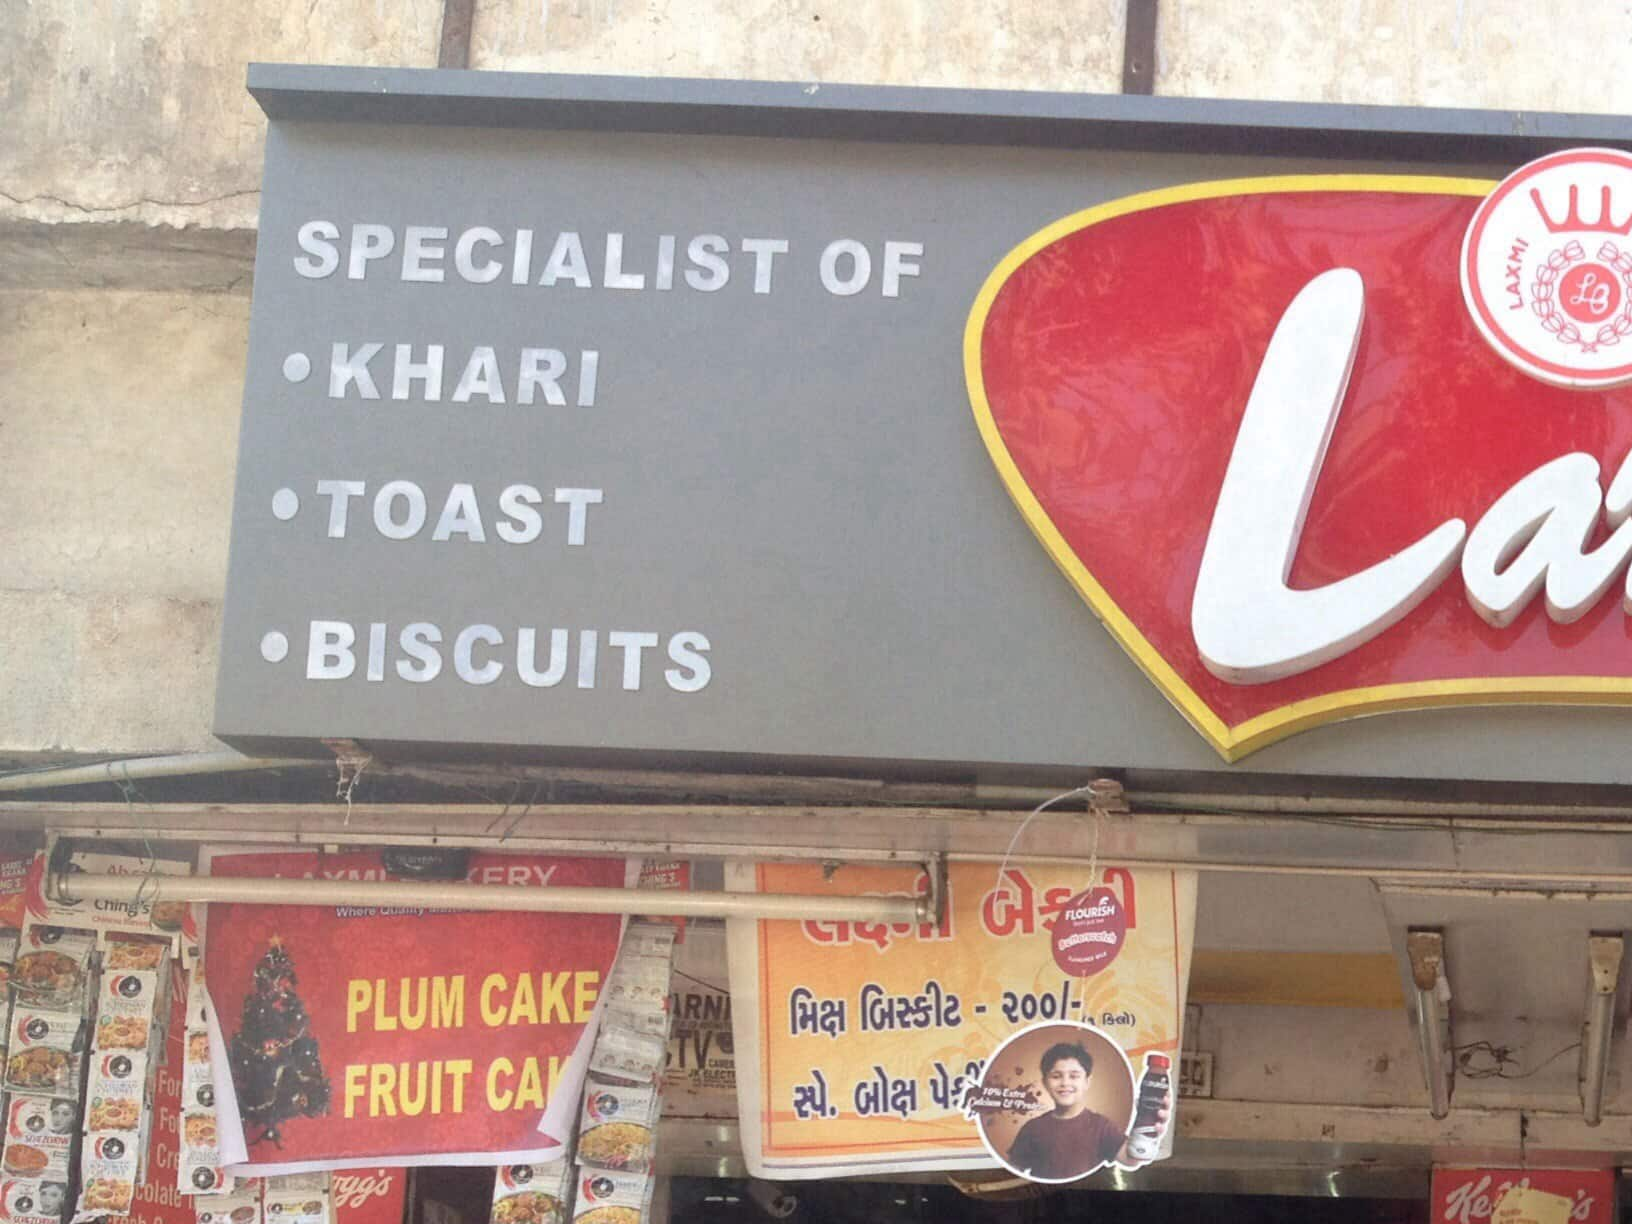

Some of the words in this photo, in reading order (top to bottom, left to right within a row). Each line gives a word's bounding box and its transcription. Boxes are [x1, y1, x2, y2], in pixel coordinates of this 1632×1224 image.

[293, 221, 789, 295] SPECIALIST
[819, 238, 925, 297] OF
[1505, 237, 1529, 310] LAXMI
[328, 342, 600, 407] KHARI
[316, 480, 603, 545] TOAST
[305, 620, 712, 692] BISCUITS
[1065, 904, 1115, 921] FLOURISH
[346, 977, 462, 1032] PLUM
[480, 971, 600, 1027] CAKE
[343, 1060, 472, 1118] FRUIT
